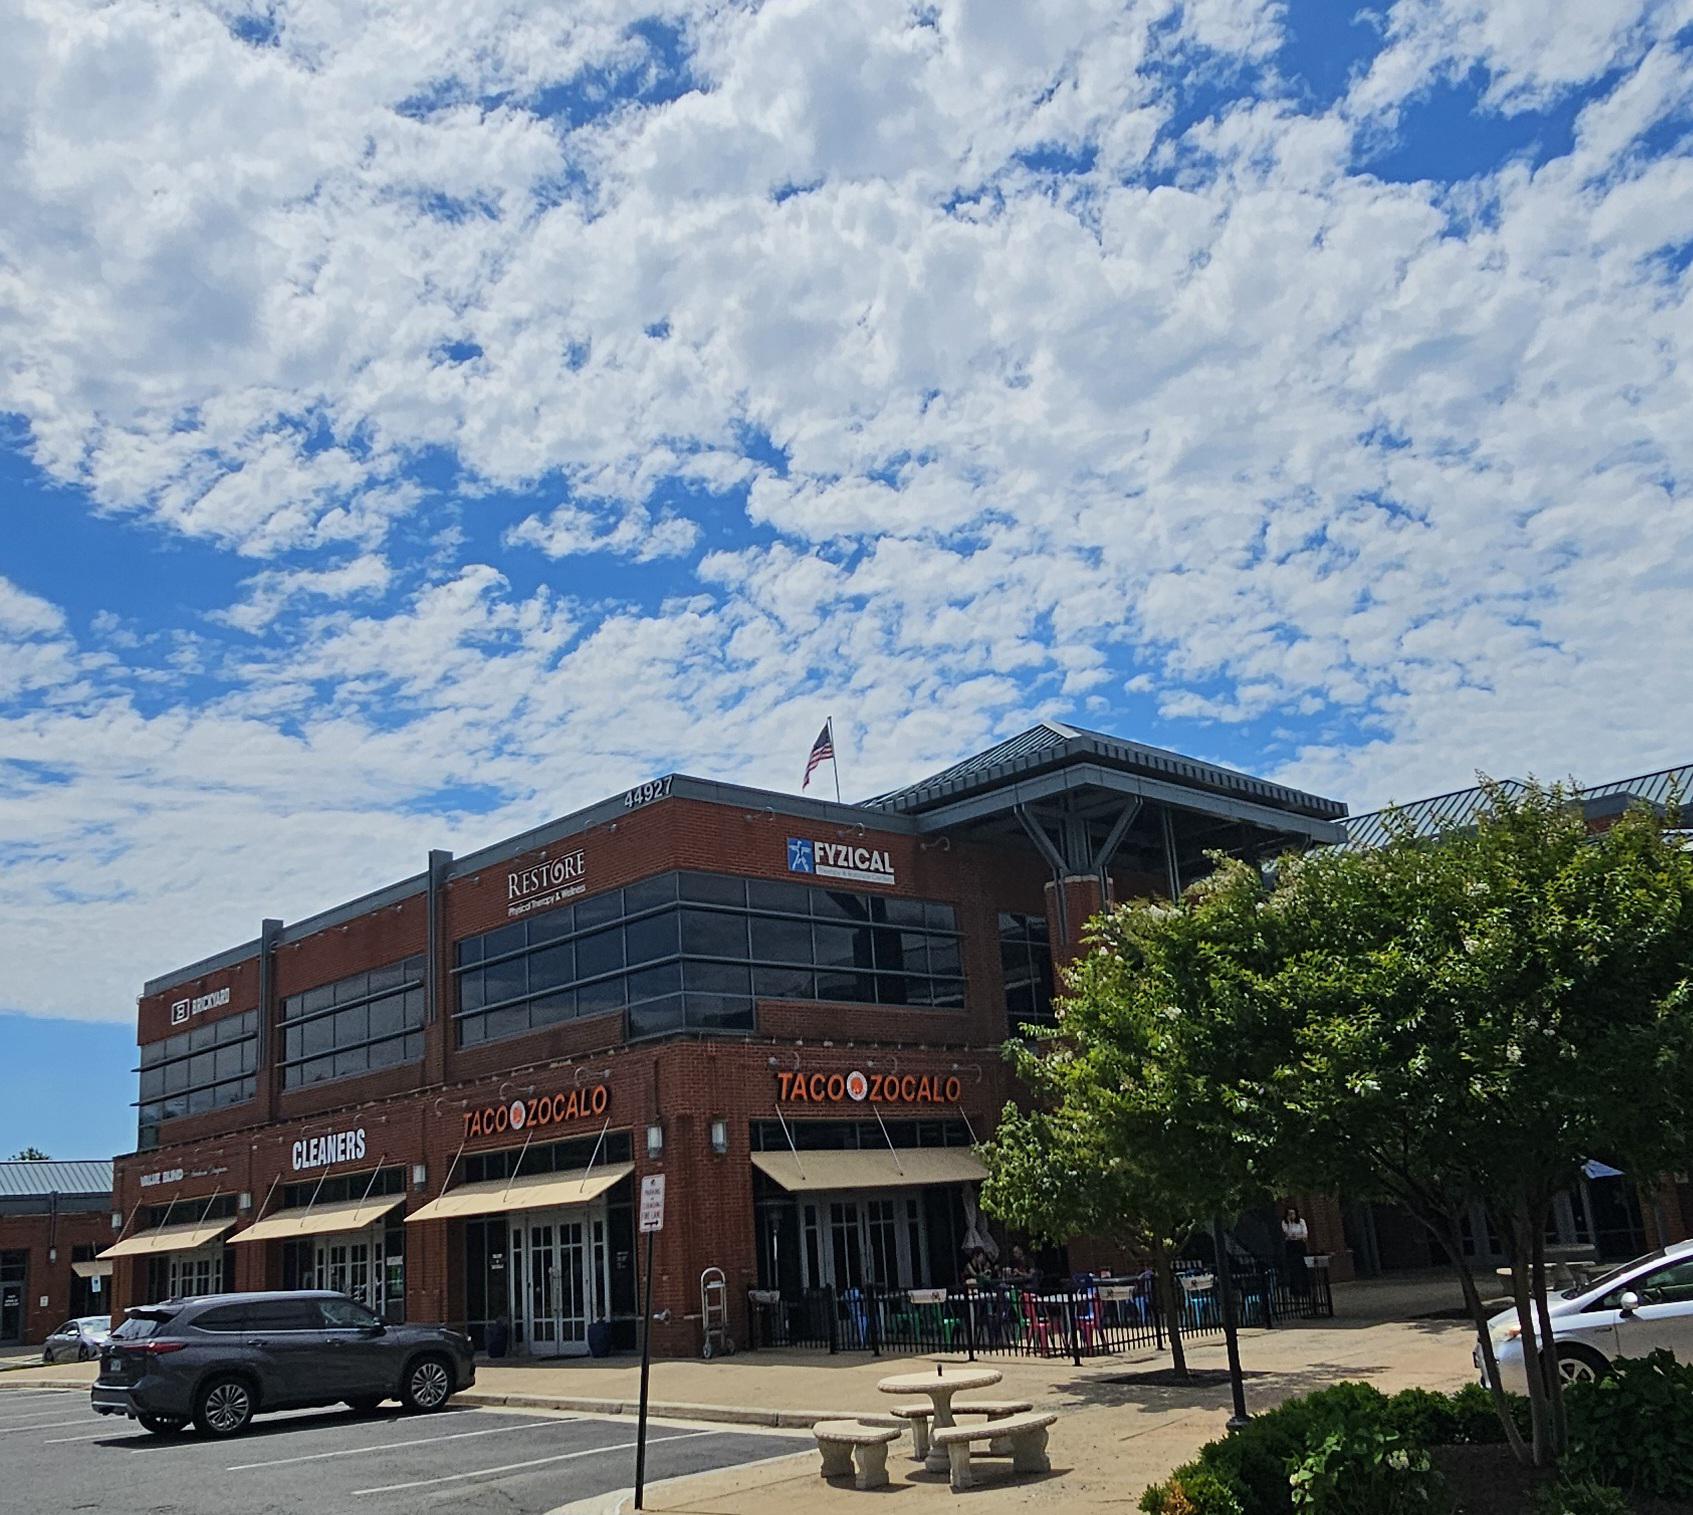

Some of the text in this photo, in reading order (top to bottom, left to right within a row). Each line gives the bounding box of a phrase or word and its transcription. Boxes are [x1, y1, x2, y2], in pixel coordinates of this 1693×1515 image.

[624, 775, 673, 808] 44927
[814, 841, 895, 873] FYZICAL
[507, 852, 586, 899] RESTORE
[508, 902, 531, 917] Physical
[532, 895, 555, 909] Therapy
[777, 1072, 961, 1103] TACO ZOCALO
[463, 1084, 608, 1138] TACO ZOCALO
[292, 1128, 366, 1171] CLEANERS
